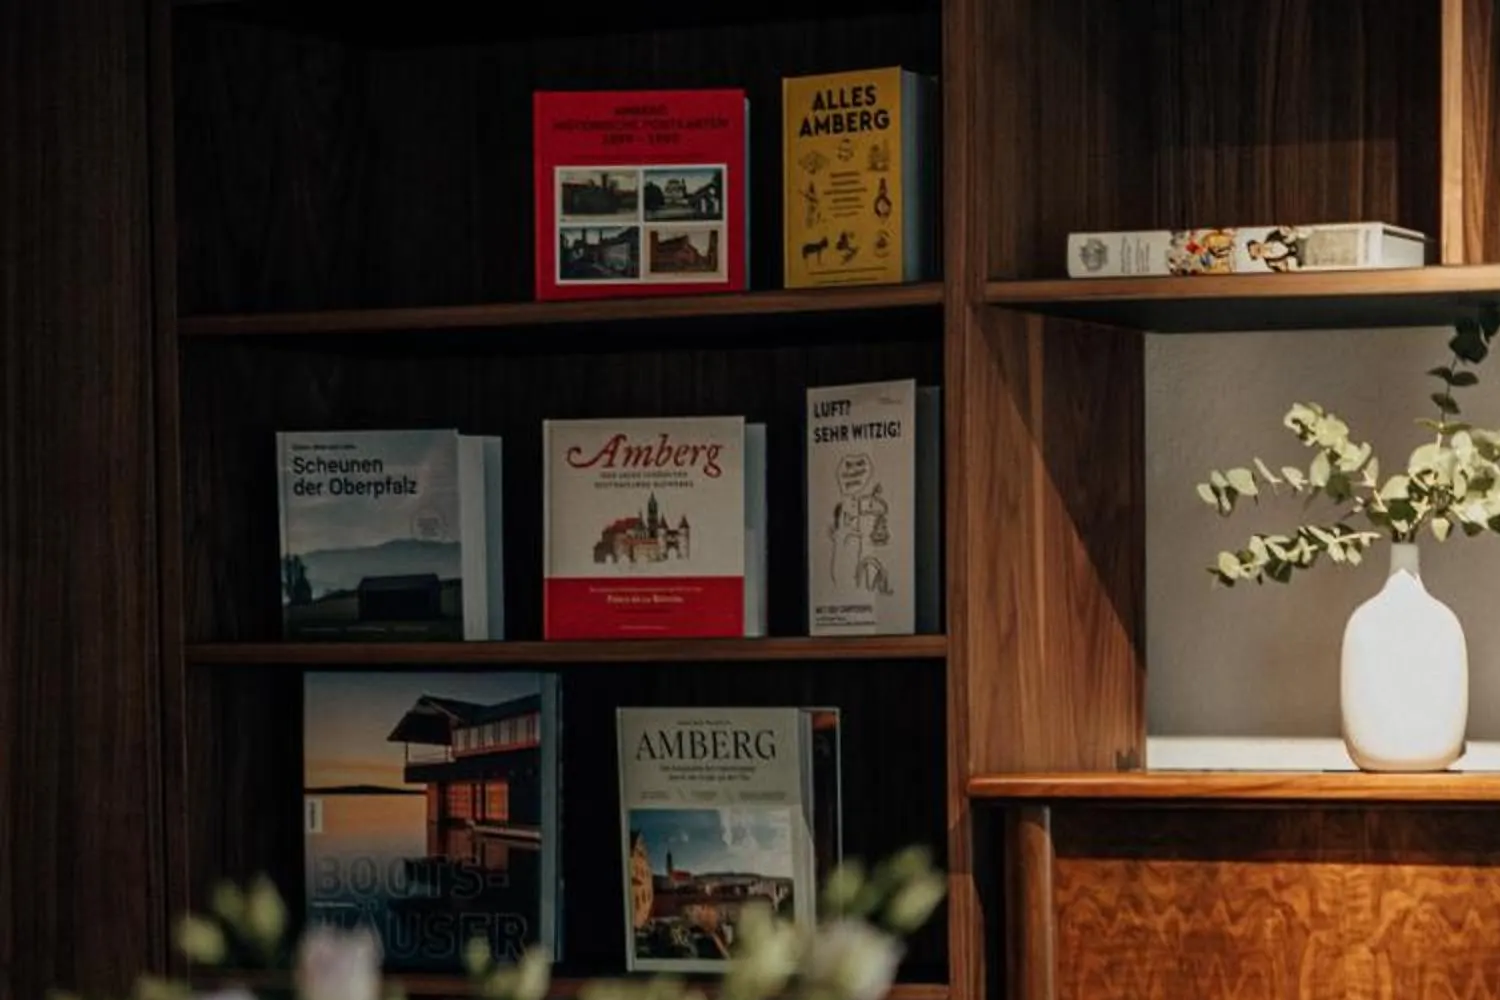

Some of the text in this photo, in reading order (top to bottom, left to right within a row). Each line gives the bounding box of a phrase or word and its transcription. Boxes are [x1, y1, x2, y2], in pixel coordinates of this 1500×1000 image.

[813, 85, 876, 111] ALLES
[800, 109, 890, 137] AMBERG
[814, 400, 851, 418] LUFT?
[815, 421, 901, 443] SEHR WITZIG!
[293, 457, 383, 474] Scheunen
[566, 434, 723, 478] Amberg
[293, 475, 418, 499] der Oberpfalz
[635, 729, 776, 761] AMBERG
[314, 854, 510, 899] BOOTS-
